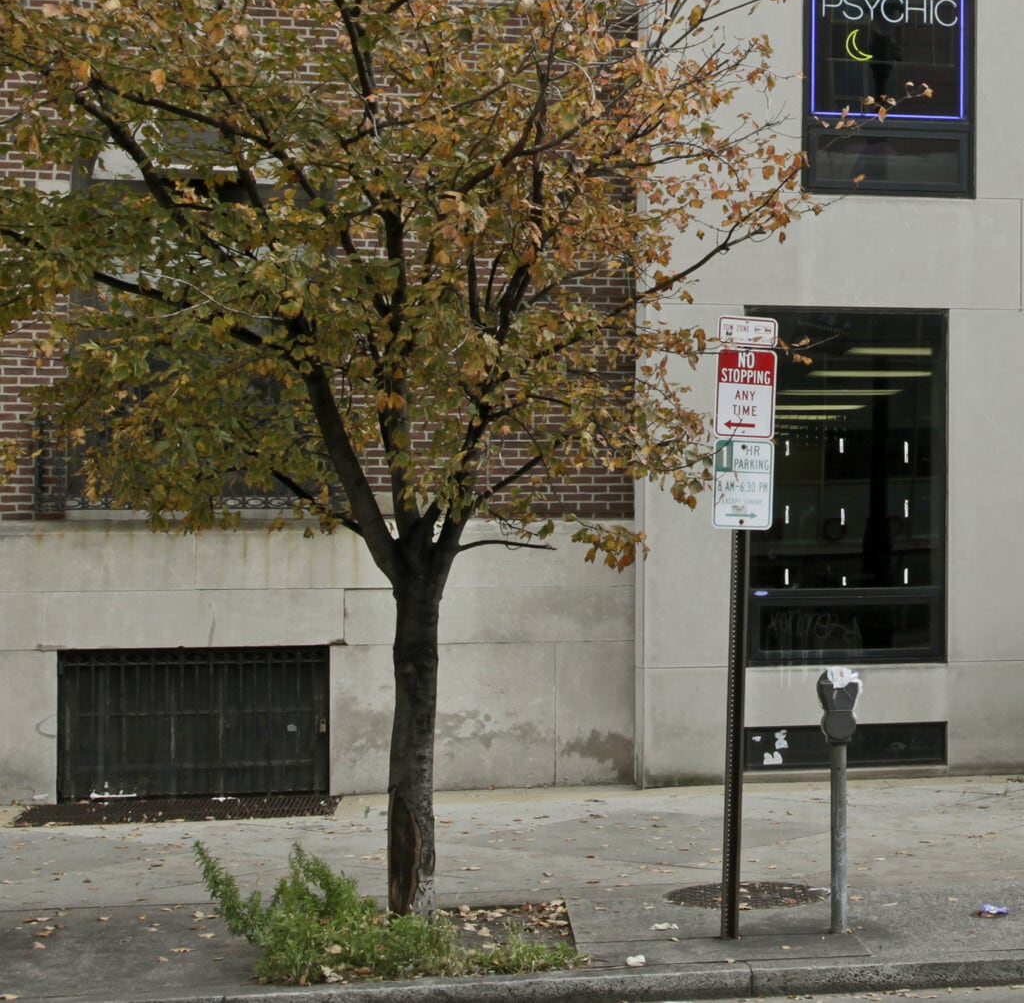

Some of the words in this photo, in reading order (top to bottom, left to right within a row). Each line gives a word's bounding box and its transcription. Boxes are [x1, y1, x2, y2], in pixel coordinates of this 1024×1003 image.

[736, 324, 751, 333] ZONE
[738, 351, 755, 369] NO
[721, 368, 771, 385] STOPPING
[734, 389, 756, 402] ANY
[732, 404, 757, 417] TIME
[722, 446, 728, 468] 1
[745, 445, 760, 456] HR
[734, 458, 769, 471] PARKING
